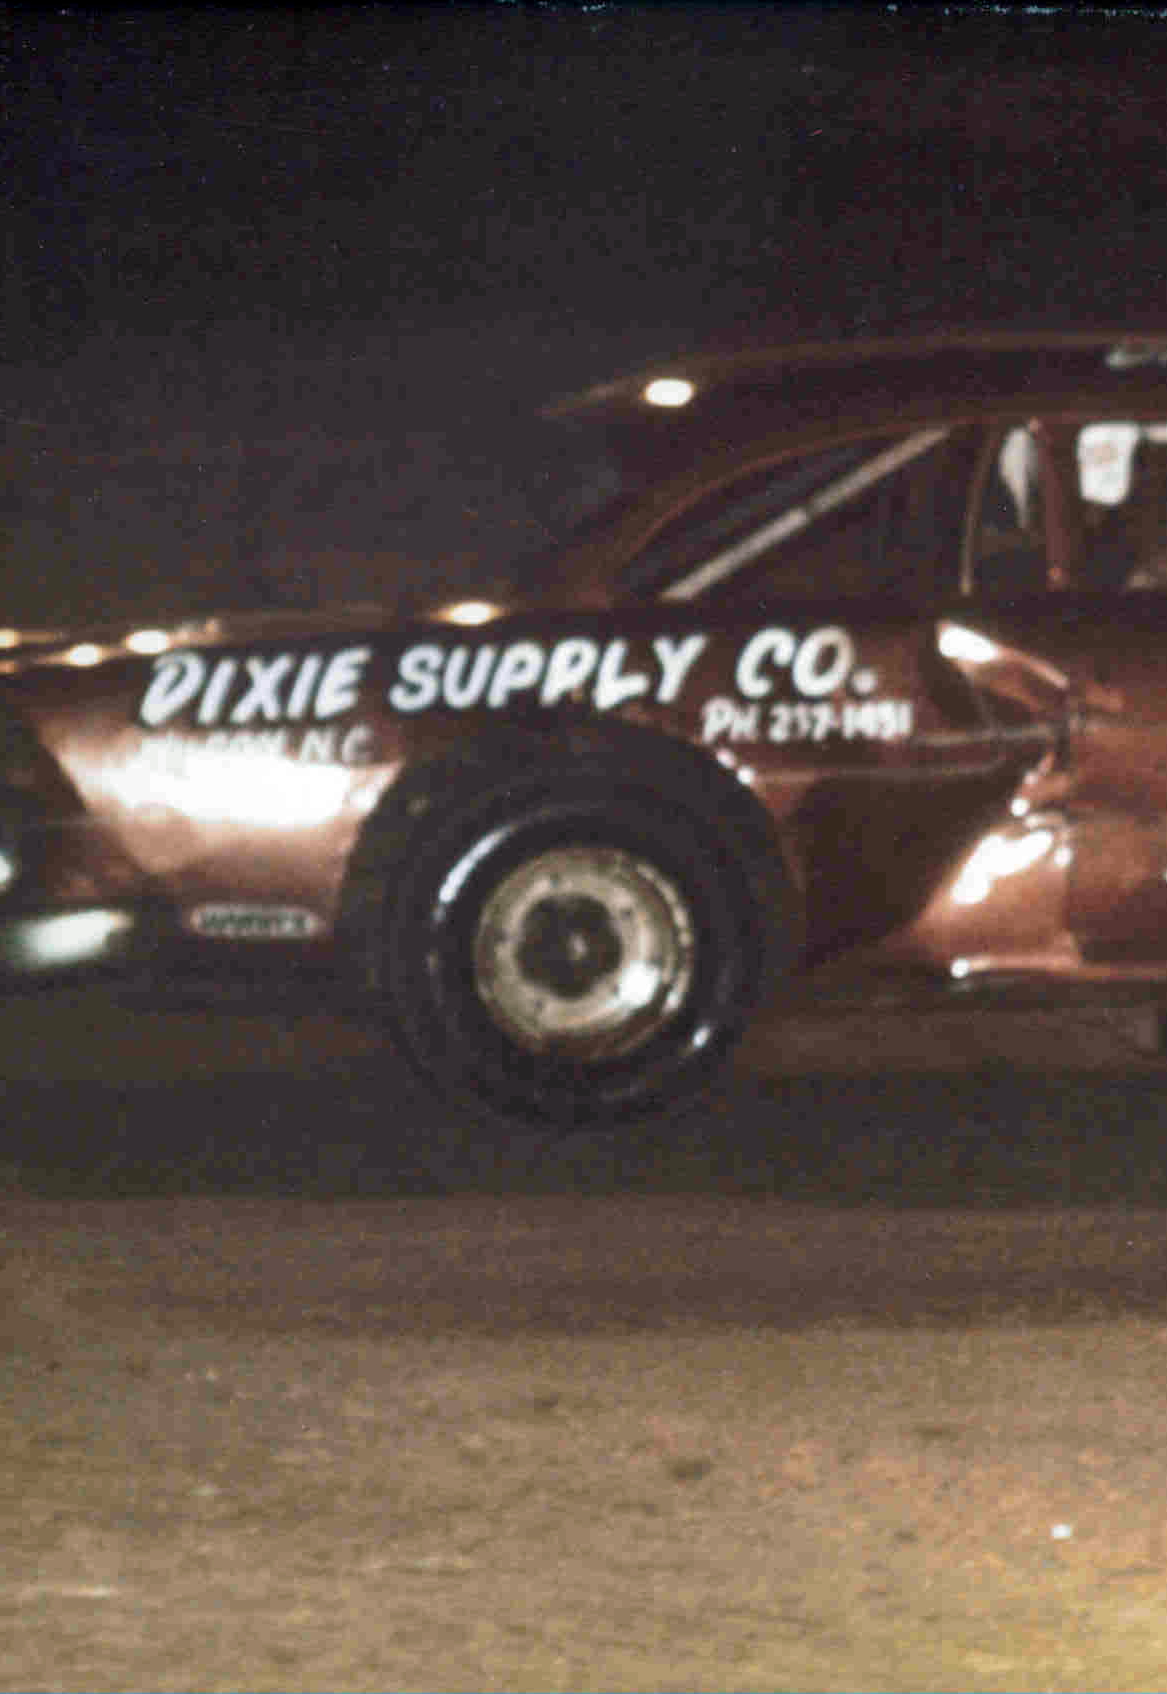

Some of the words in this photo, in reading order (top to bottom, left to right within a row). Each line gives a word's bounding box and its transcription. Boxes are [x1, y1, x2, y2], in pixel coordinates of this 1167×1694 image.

[140, 647, 371, 726] DIXIE
[389, 634, 706, 712] SUPPLY
[735, 625, 878, 698] CO.
